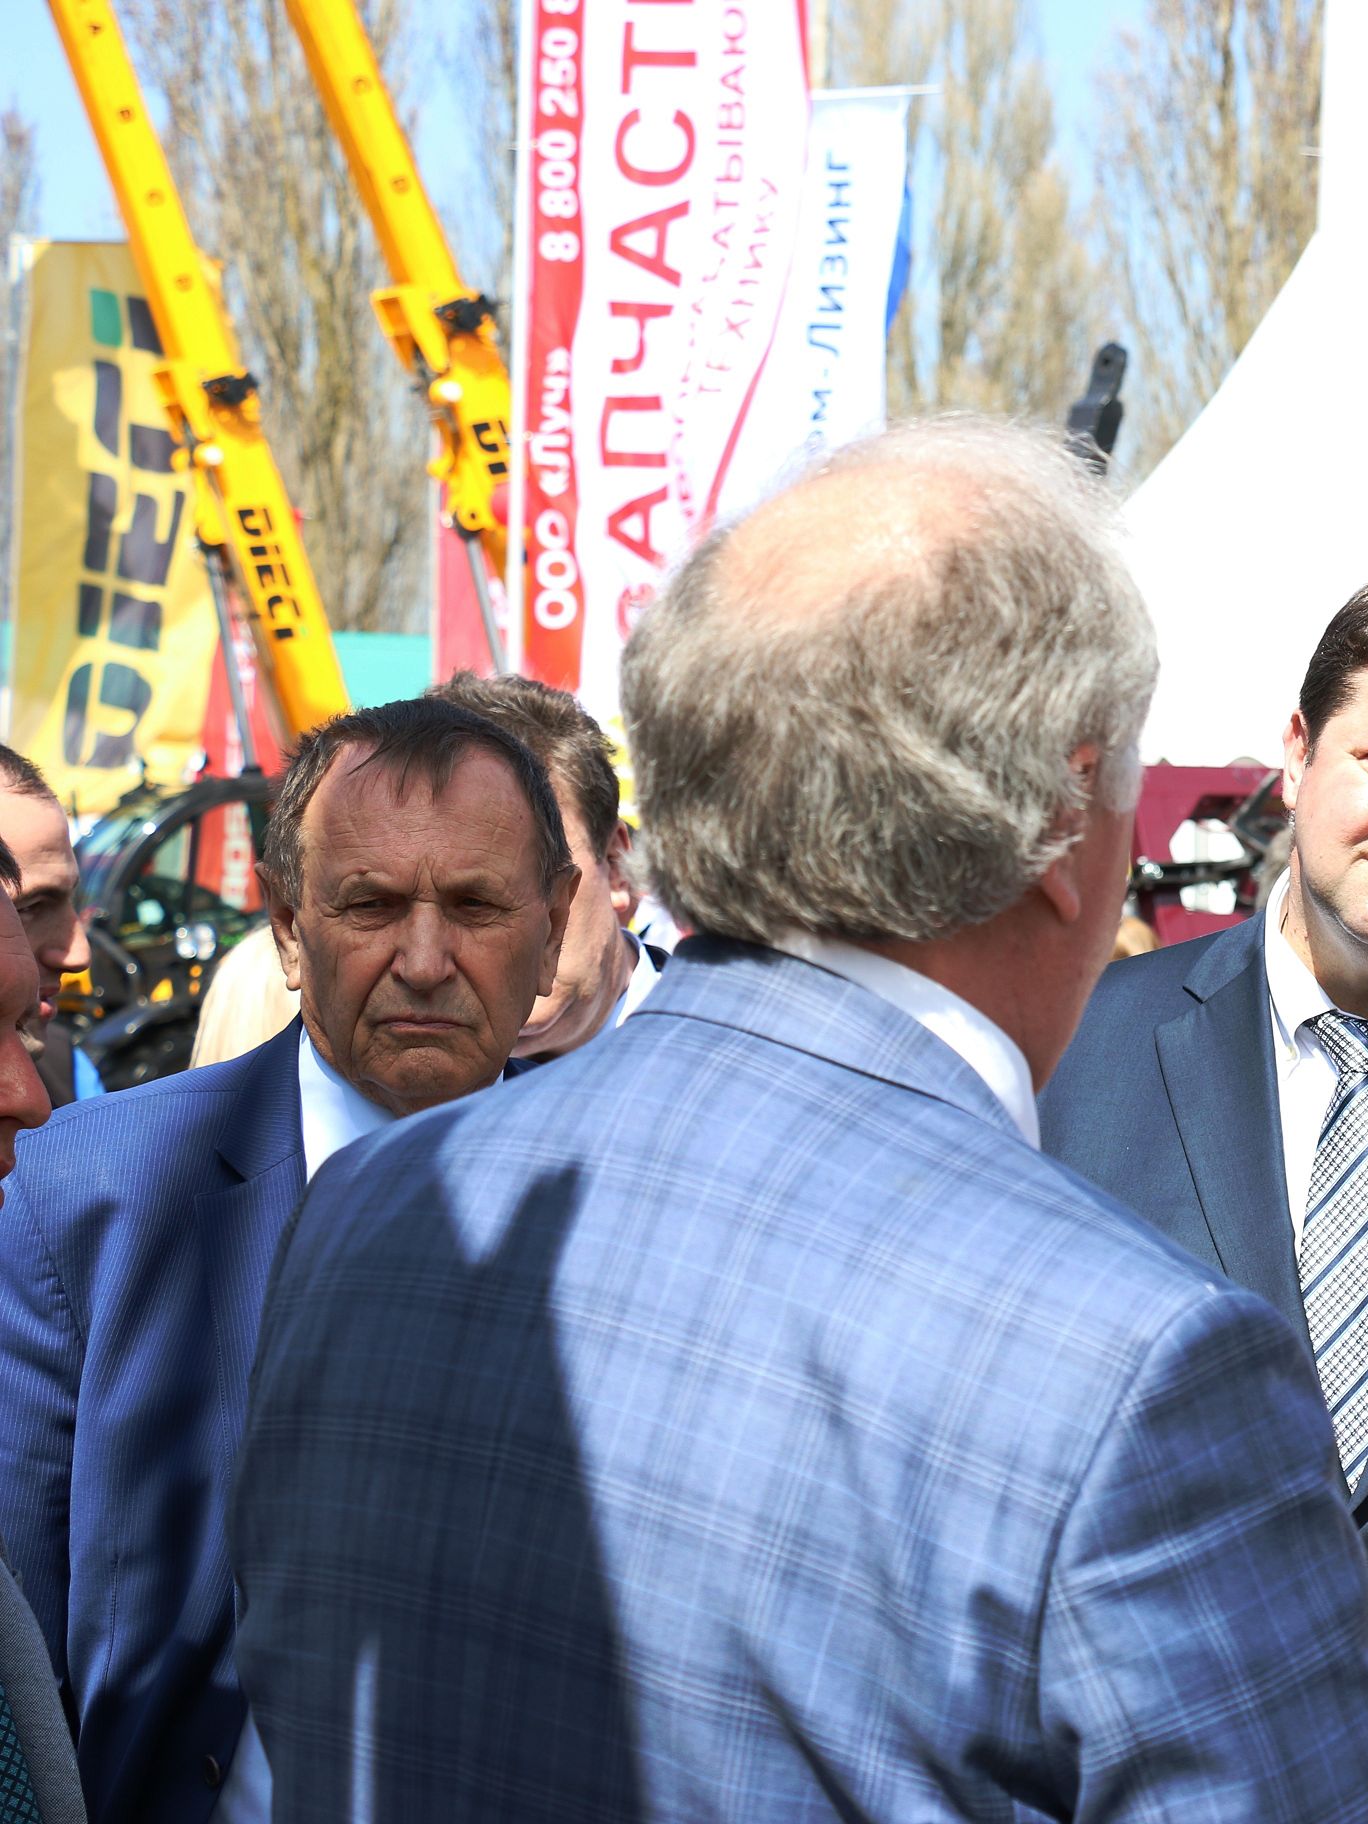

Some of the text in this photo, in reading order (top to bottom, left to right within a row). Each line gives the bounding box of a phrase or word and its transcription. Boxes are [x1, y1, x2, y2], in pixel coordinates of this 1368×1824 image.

[539, 27, 580, 118] 250
[537, 129, 579, 219] 800
[539, 231, 580, 262] 8
[600, 0, 698, 647] АПЧАСТ
[533, 509, 578, 630] ООО
